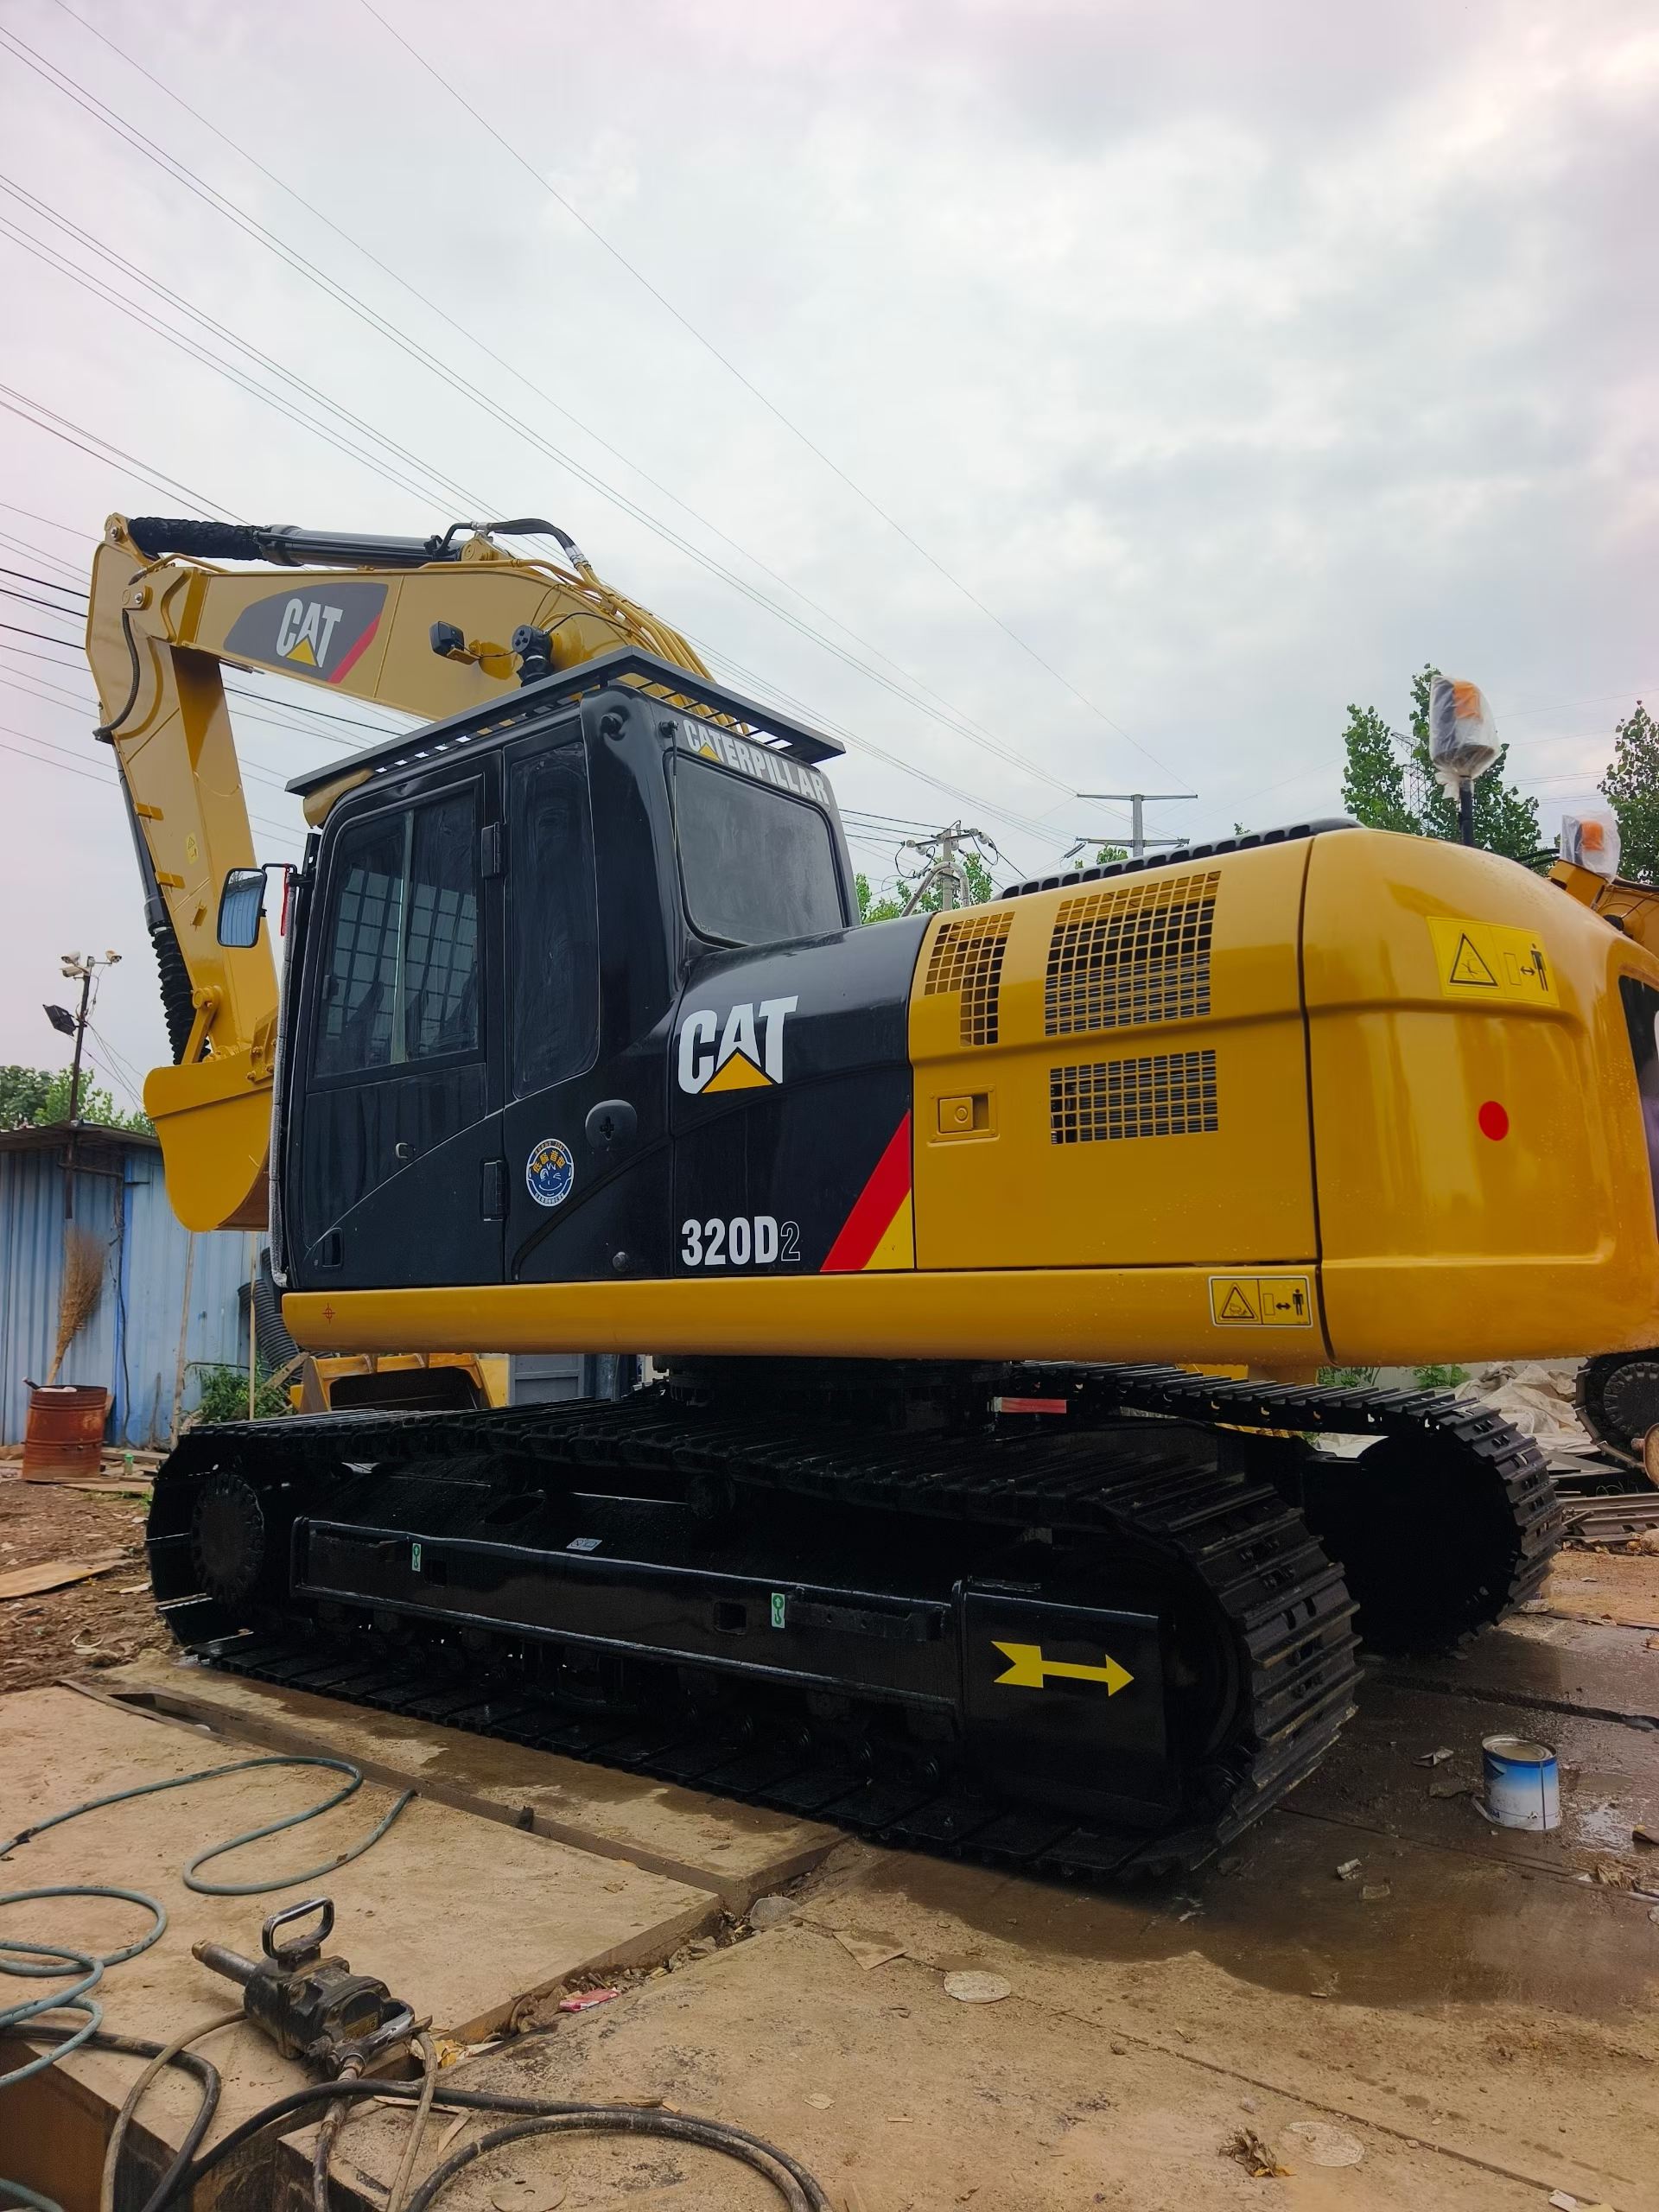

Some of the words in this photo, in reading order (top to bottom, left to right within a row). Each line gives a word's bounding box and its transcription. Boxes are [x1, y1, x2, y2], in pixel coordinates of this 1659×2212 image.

[276, 598, 344, 668] CAT
[683, 720, 830, 804] CATERPILLAR
[677, 995, 799, 1095] CAT
